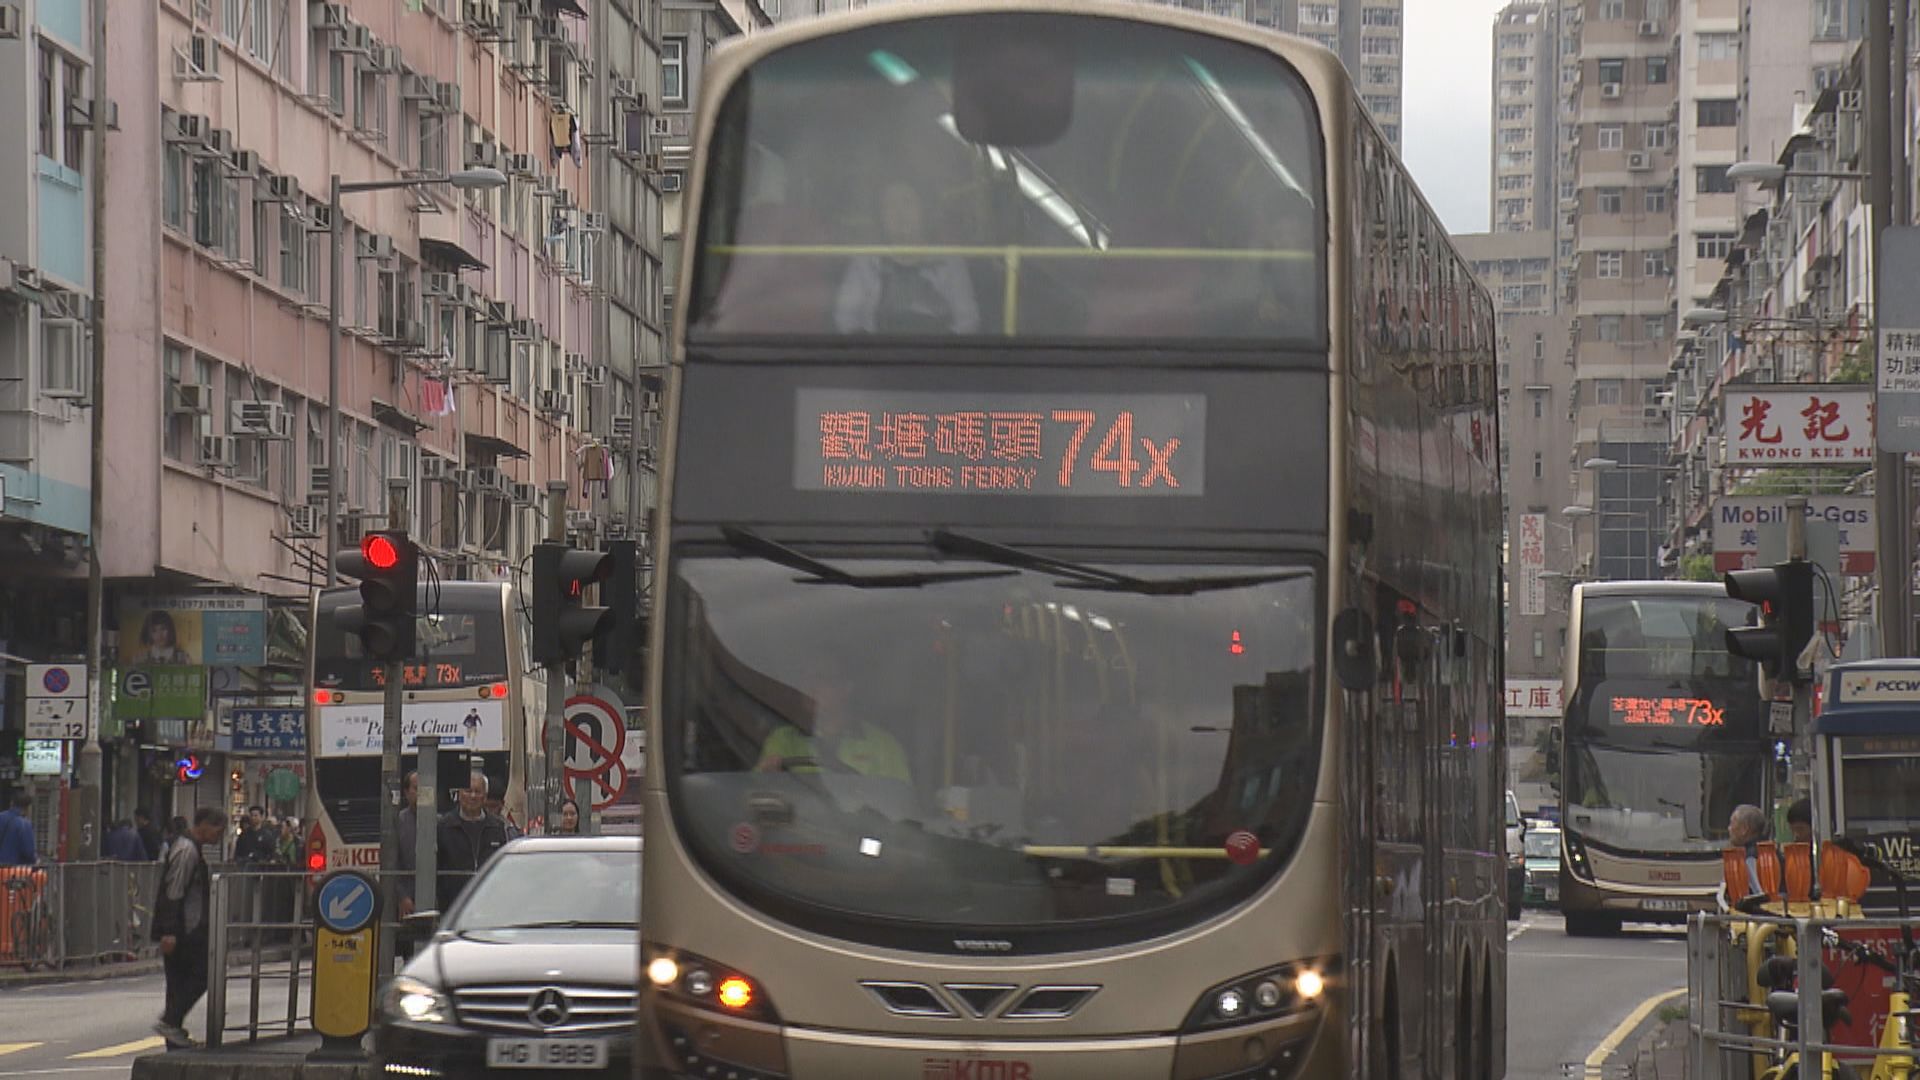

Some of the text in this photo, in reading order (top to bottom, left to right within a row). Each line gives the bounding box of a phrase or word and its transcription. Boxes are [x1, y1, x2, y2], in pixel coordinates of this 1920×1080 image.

[1739, 396, 1875, 443] 光記
[820, 411, 1043, 461] 觀塘碼頭
[1739, 448, 1801, 459] KWONG
[1811, 448, 1844, 458] KEE
[824, 465, 1036, 488] KWUN TONG FERRY
[1722, 503, 1868, 523] Mobil P-Gas
[64, 701, 74, 714] 7
[65, 723, 83, 737] 12
[421, 719, 458, 734] Chan
[352, 848, 380, 865] KM
[497, 1044, 595, 1063] HG 1989
